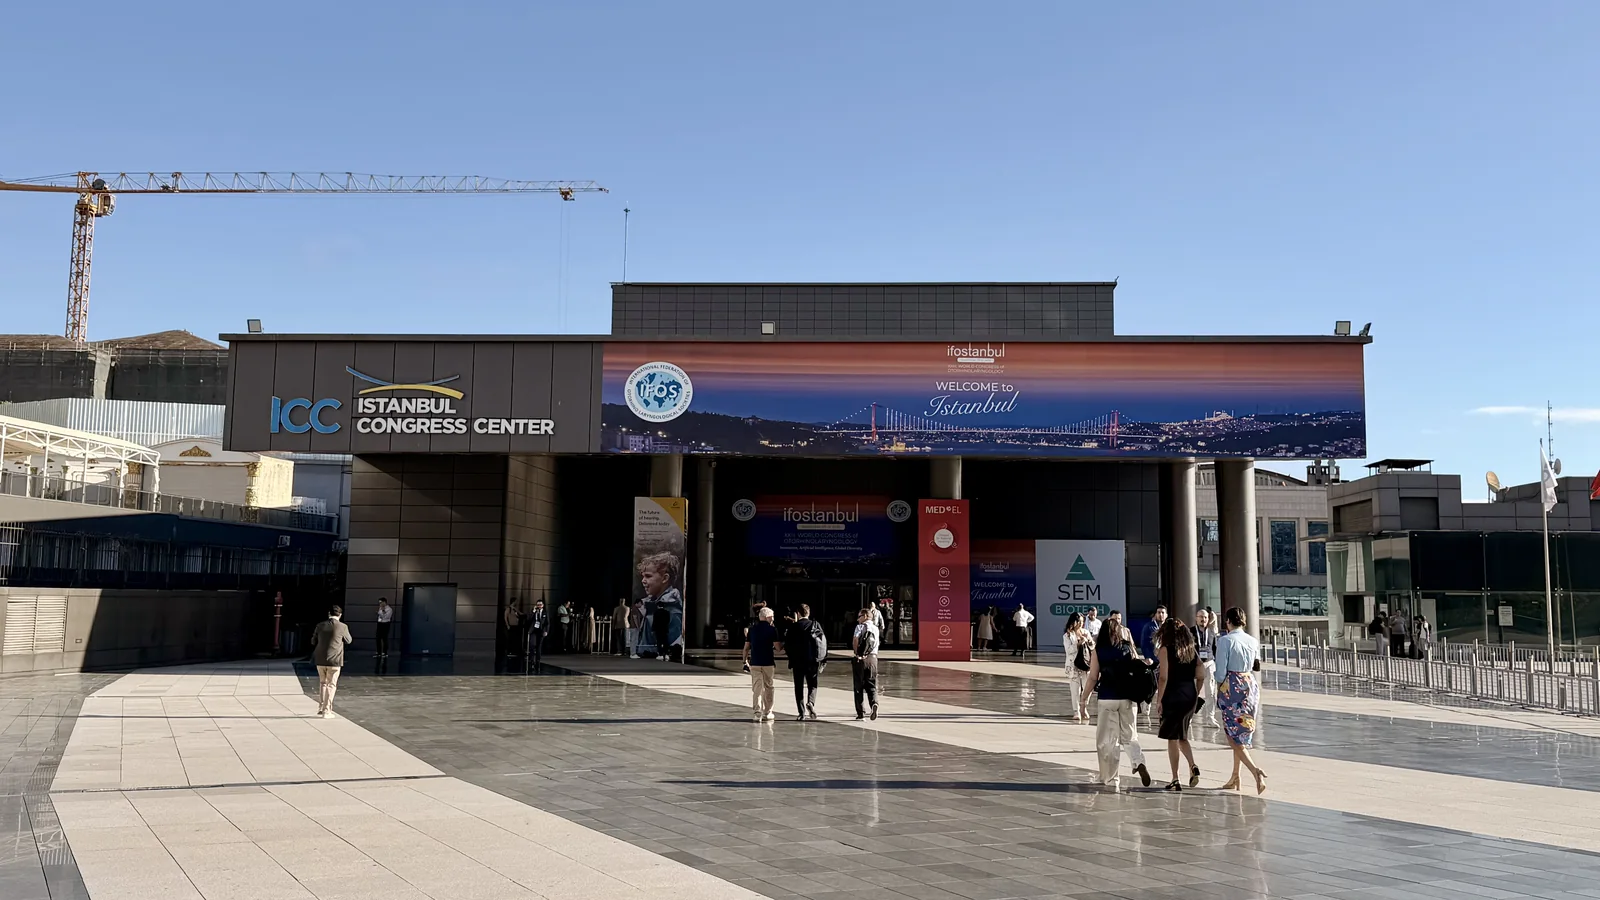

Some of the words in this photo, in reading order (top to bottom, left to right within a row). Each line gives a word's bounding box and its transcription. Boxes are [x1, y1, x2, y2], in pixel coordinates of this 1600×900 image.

[947, 342, 1005, 357] ifostanbul
[640, 384, 678, 398] IFOS
[935, 381, 999, 391] WELCOME
[1001, 383, 1014, 392] to
[357, 397, 457, 414] ISTANBUL
[923, 390, 1020, 417] Istanbul
[270, 395, 342, 434] ICC
[356, 417, 468, 434] CONGRESS
[473, 418, 555, 435] CENTER
[783, 501, 859, 522] ifostanbul
[970, 586, 1018, 601] Istanbul
[1057, 584, 1101, 600] SEM
[1055, 605, 1105, 614] BIOTEH
